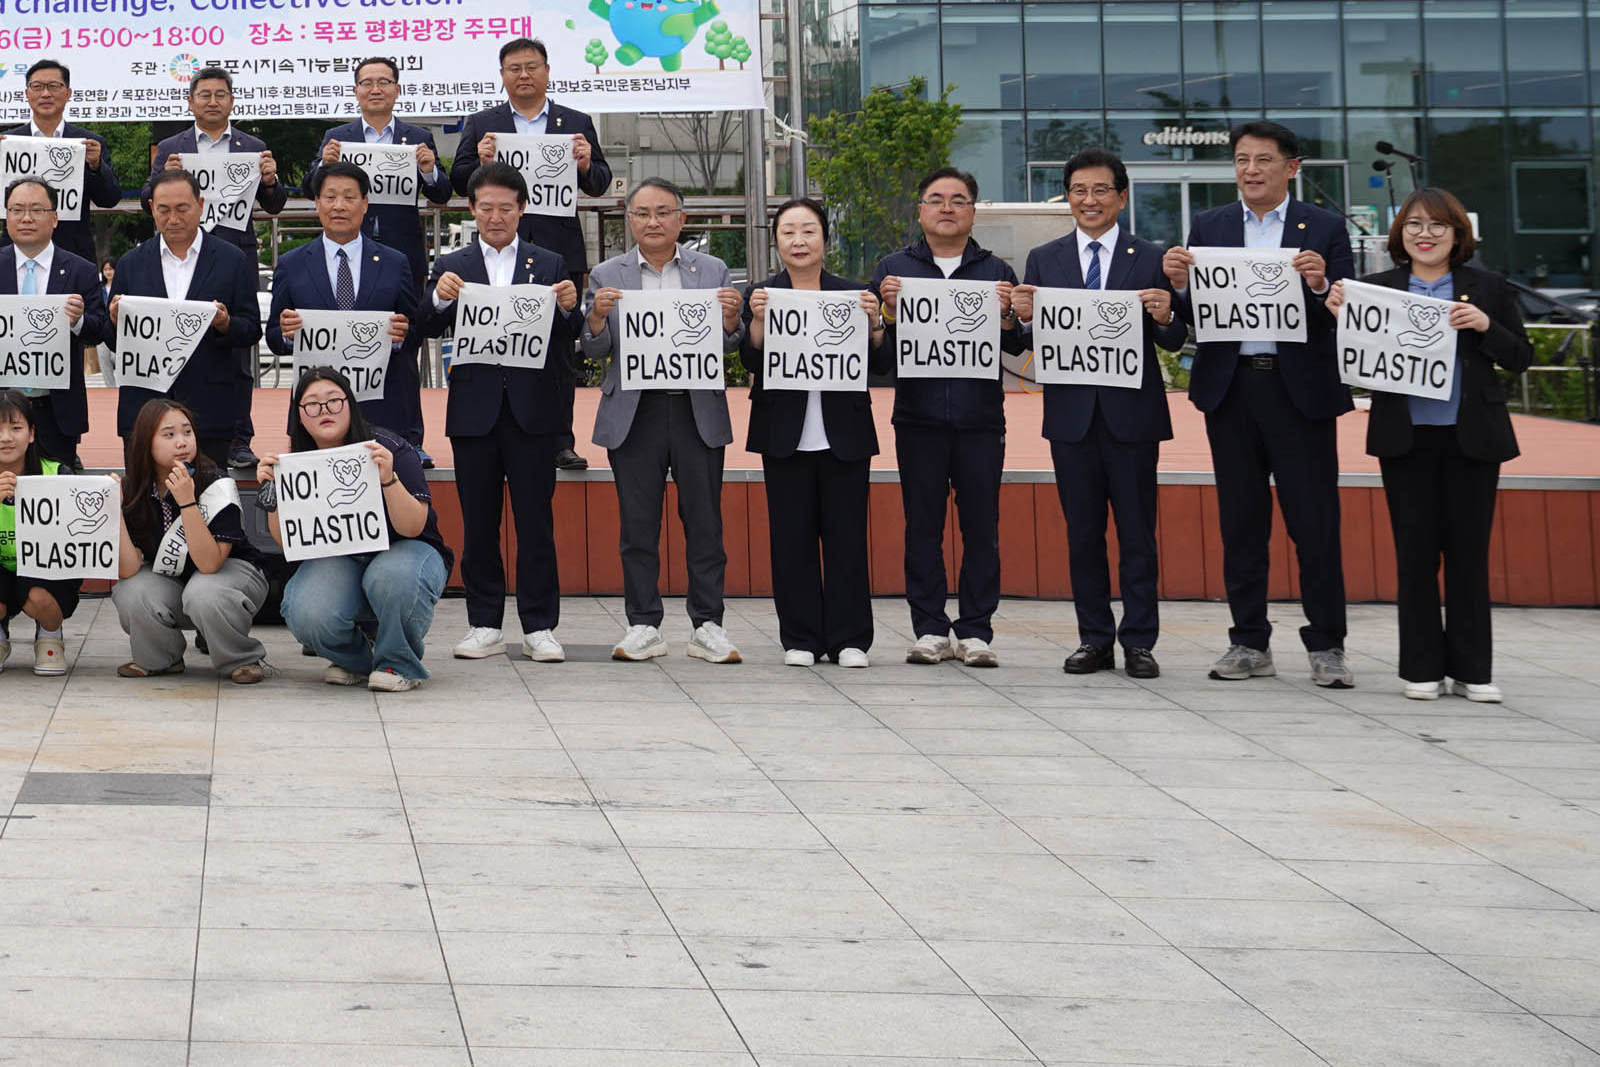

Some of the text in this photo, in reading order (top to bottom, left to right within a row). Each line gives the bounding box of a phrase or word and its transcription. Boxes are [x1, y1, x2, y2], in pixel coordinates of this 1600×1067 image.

[60, 24, 225, 49] 15:00~18:00
[249, 21, 294, 46] 장소
[313, 20, 358, 44] 목포
[364, 17, 457, 43] 평화광장
[463, 15, 532, 41] 주무대
[130, 60, 158, 76] 주관
[68, 106, 93, 119] 목포
[95, 105, 132, 118] 환경과
[429, 99, 479, 114] 남도사랑
[1143, 126, 1231, 145] editions
[5, 151, 37, 175] NO!
[1193, 266, 1237, 290] NO!
[462, 303, 500, 327] NO!
[626, 311, 664, 338] NO!
[769, 308, 807, 337] NO!
[900, 297, 939, 324] NO!
[1040, 305, 1082, 330] NO!
[1198, 302, 1300, 330] PLASTIC
[1345, 302, 1390, 334] NO!
[123, 313, 161, 341] NO!
[299, 327, 337, 352] NO!
[456, 332, 543, 359] PLASTIC
[900, 339, 993, 368] PLASTIC
[626, 352, 719, 381] PLASTIC
[768, 351, 861, 381] PLASTIC
[1041, 344, 1138, 376] PLASTIC
[1343, 347, 1447, 389] PLASTIC
[280, 470, 319, 502] NO!
[20, 497, 60, 526] NO!
[285, 510, 380, 548] PLASTIC
[21, 540, 113, 569] PLASTIC
